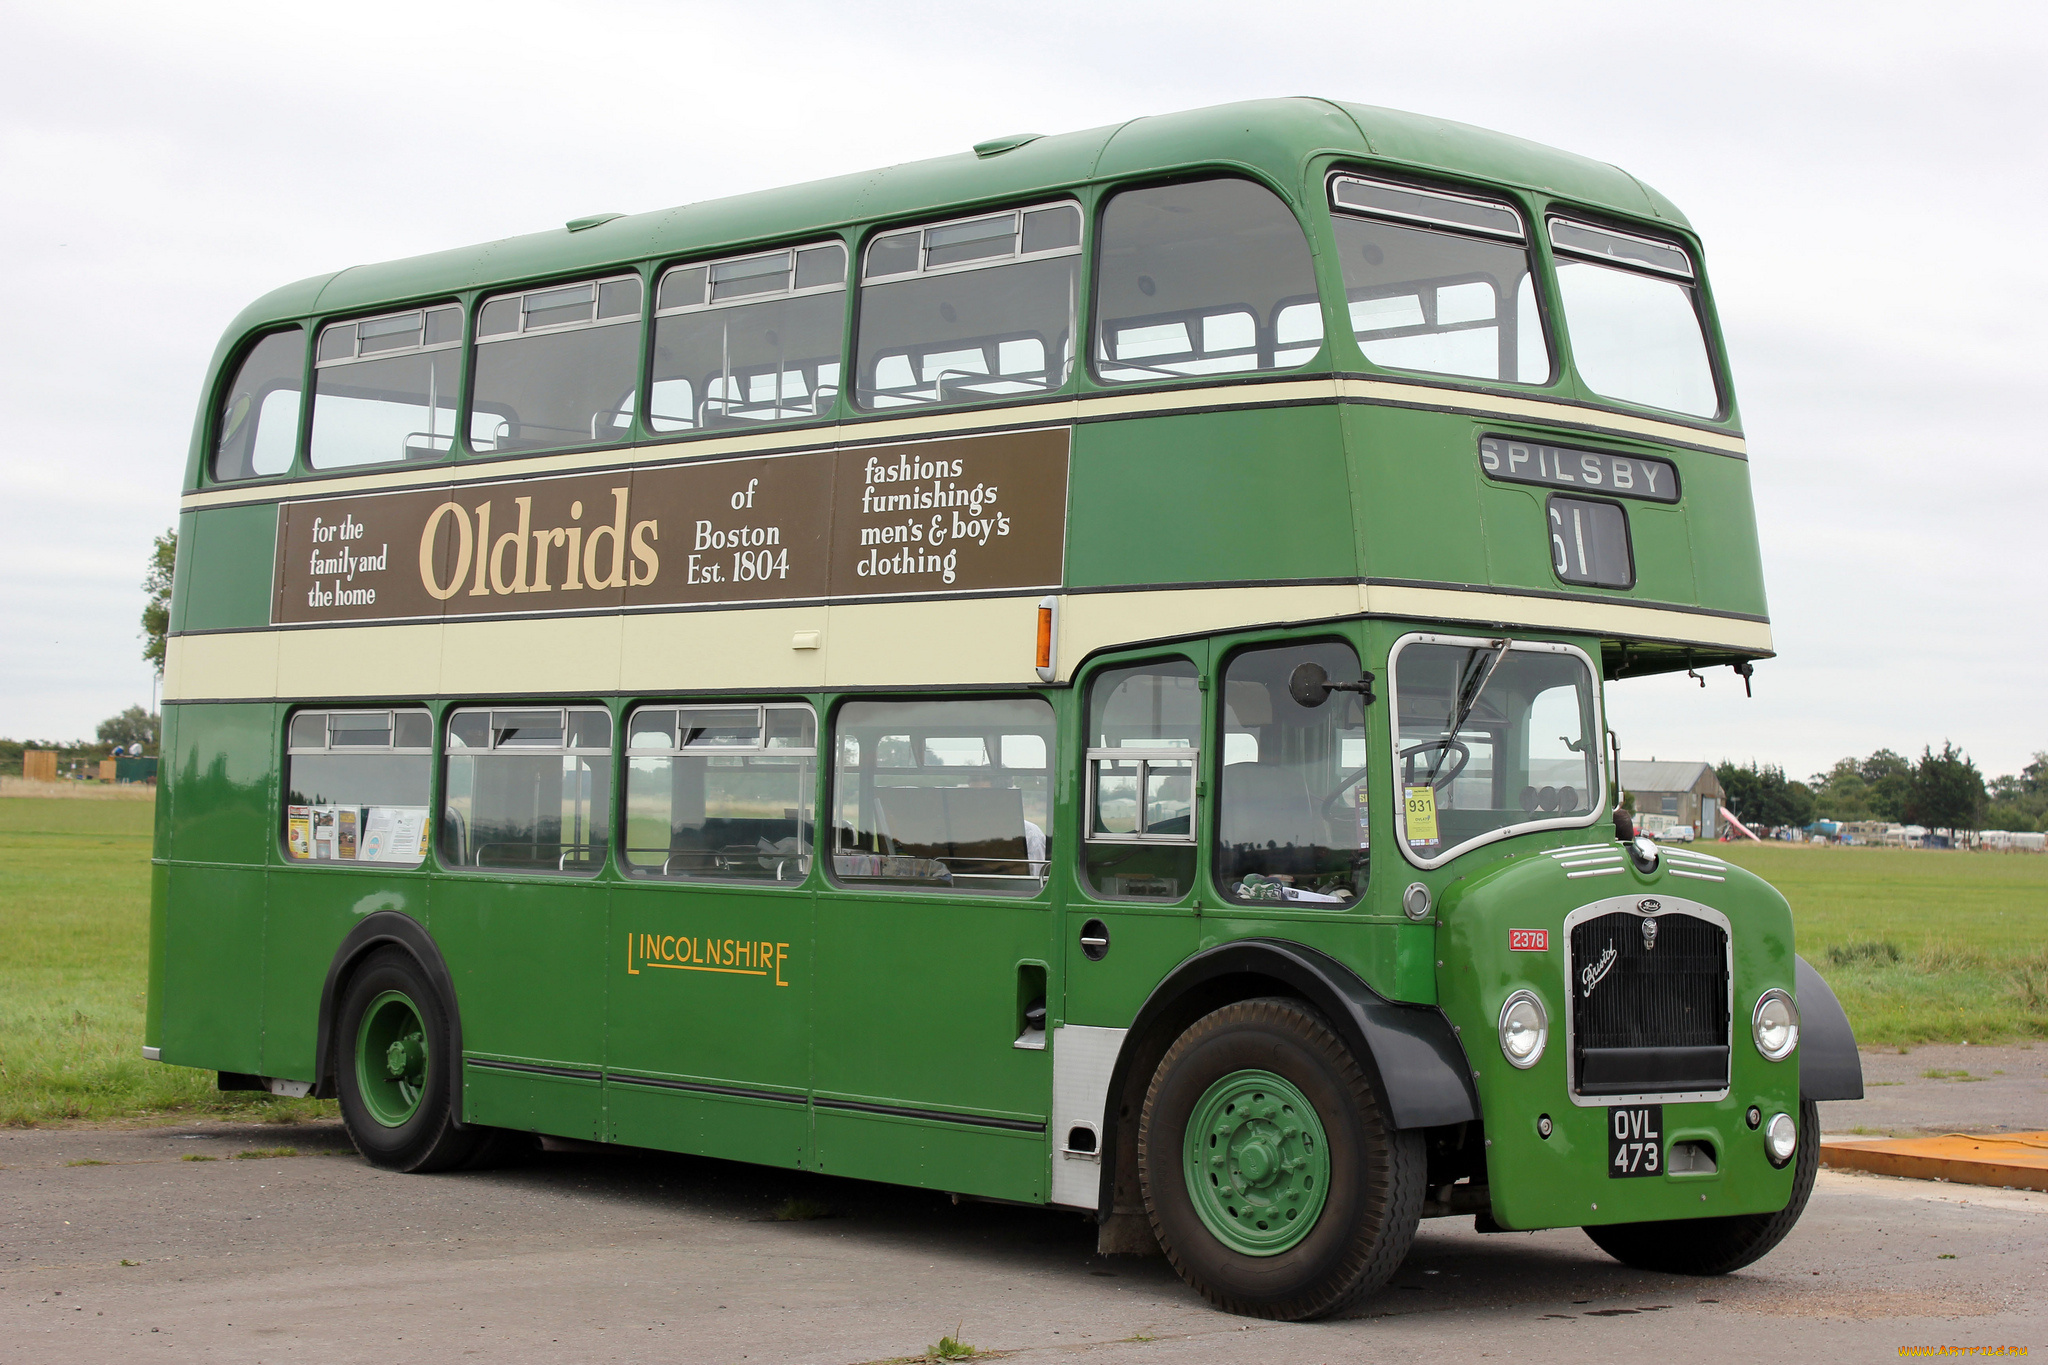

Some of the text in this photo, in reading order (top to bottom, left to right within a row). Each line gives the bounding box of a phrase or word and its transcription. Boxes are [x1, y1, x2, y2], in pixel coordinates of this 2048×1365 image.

[864, 455, 963, 484] fashions
[1481, 439, 1660, 493] SPILSBY
[730, 478, 759, 510] of
[861, 481, 998, 516] furnishings
[312, 514, 364, 543] for the
[419, 487, 659, 601] Oldrids
[694, 520, 780, 551] Boston
[860, 511, 1011, 547] men's & boy's
[310, 543, 387, 581] family and
[686, 548, 790, 585] Est. 1804
[856, 548, 957, 584] clothing
[307, 580, 376, 607] the home
[1409, 800, 1432, 812] 931
[1513, 932, 1545, 948] 2378
[628, 932, 790, 987] LINCOLNSHIRE
[1582, 938, 1617, 998] Bristol
[1614, 1110, 1658, 1139] OVL
[1614, 1142, 1658, 1173] 473
